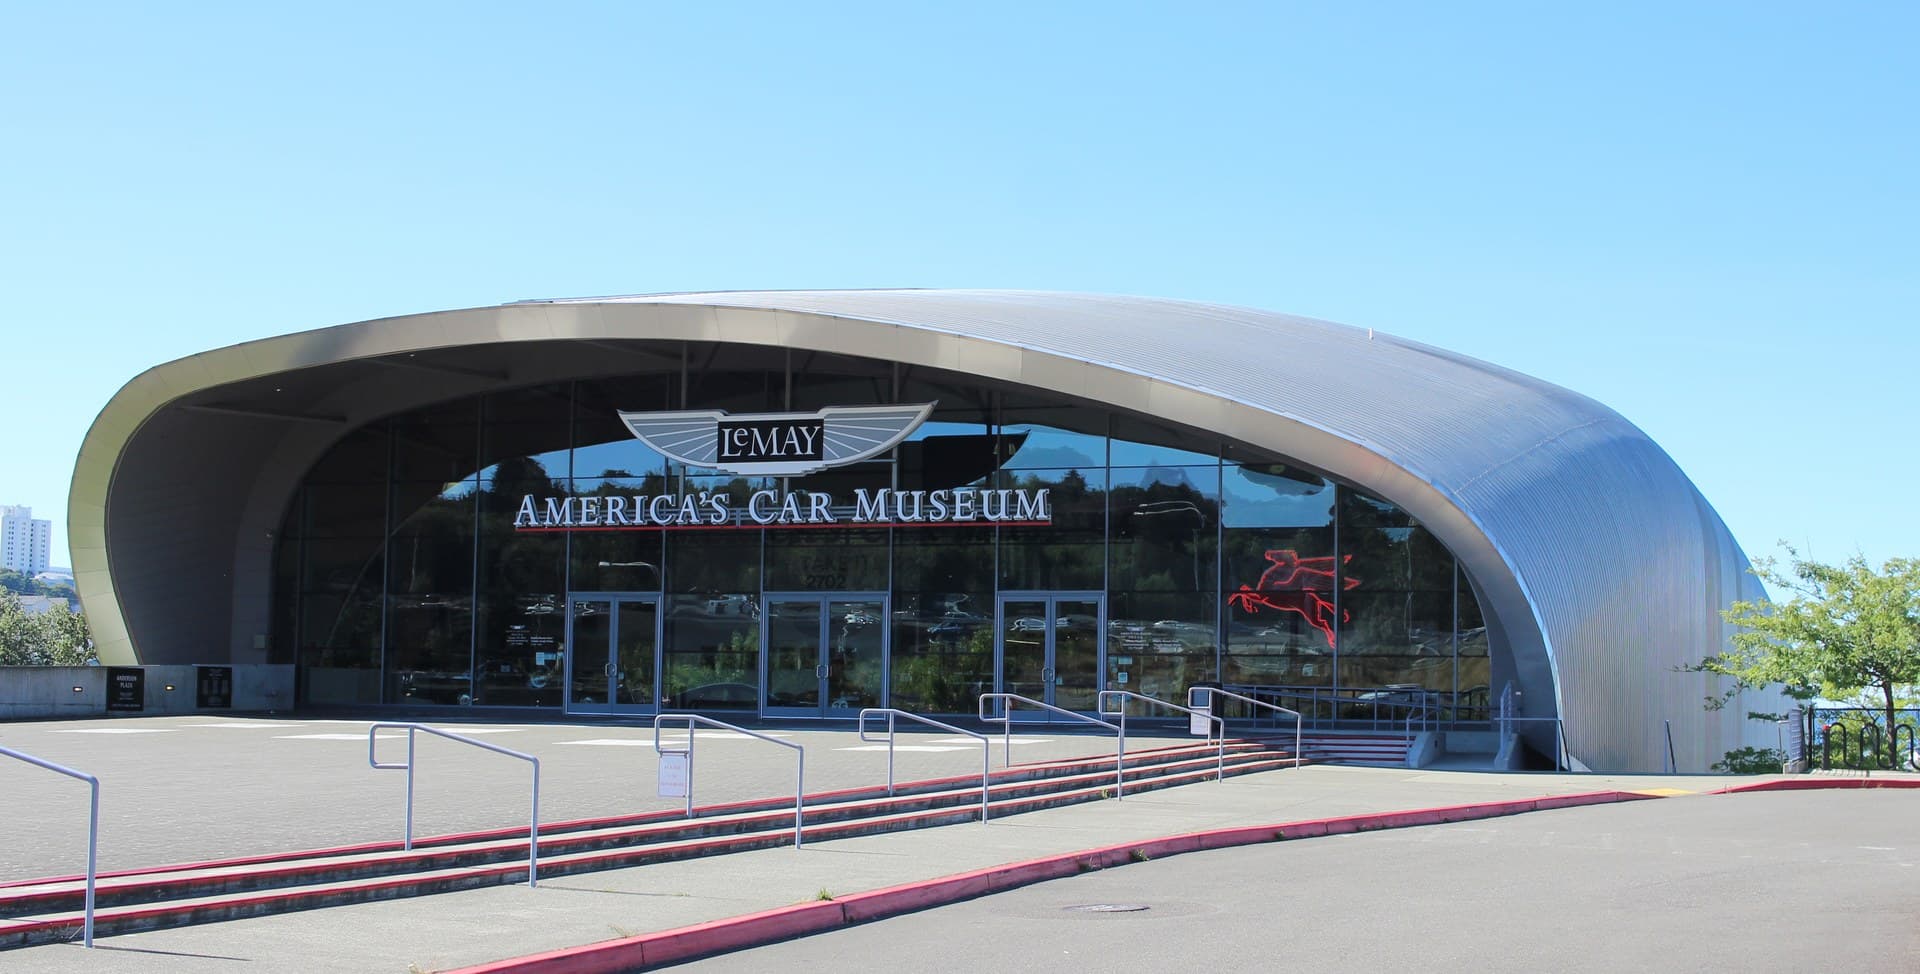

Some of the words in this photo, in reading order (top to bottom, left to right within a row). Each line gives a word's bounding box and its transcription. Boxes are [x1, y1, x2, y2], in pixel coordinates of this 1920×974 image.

[721, 425, 822, 457] LeMAY
[513, 493, 731, 527] AMERICA'S
[749, 489, 837, 524] CAR
[852, 487, 1051, 523] MUSEUM
[806, 575, 846, 588] 2702
